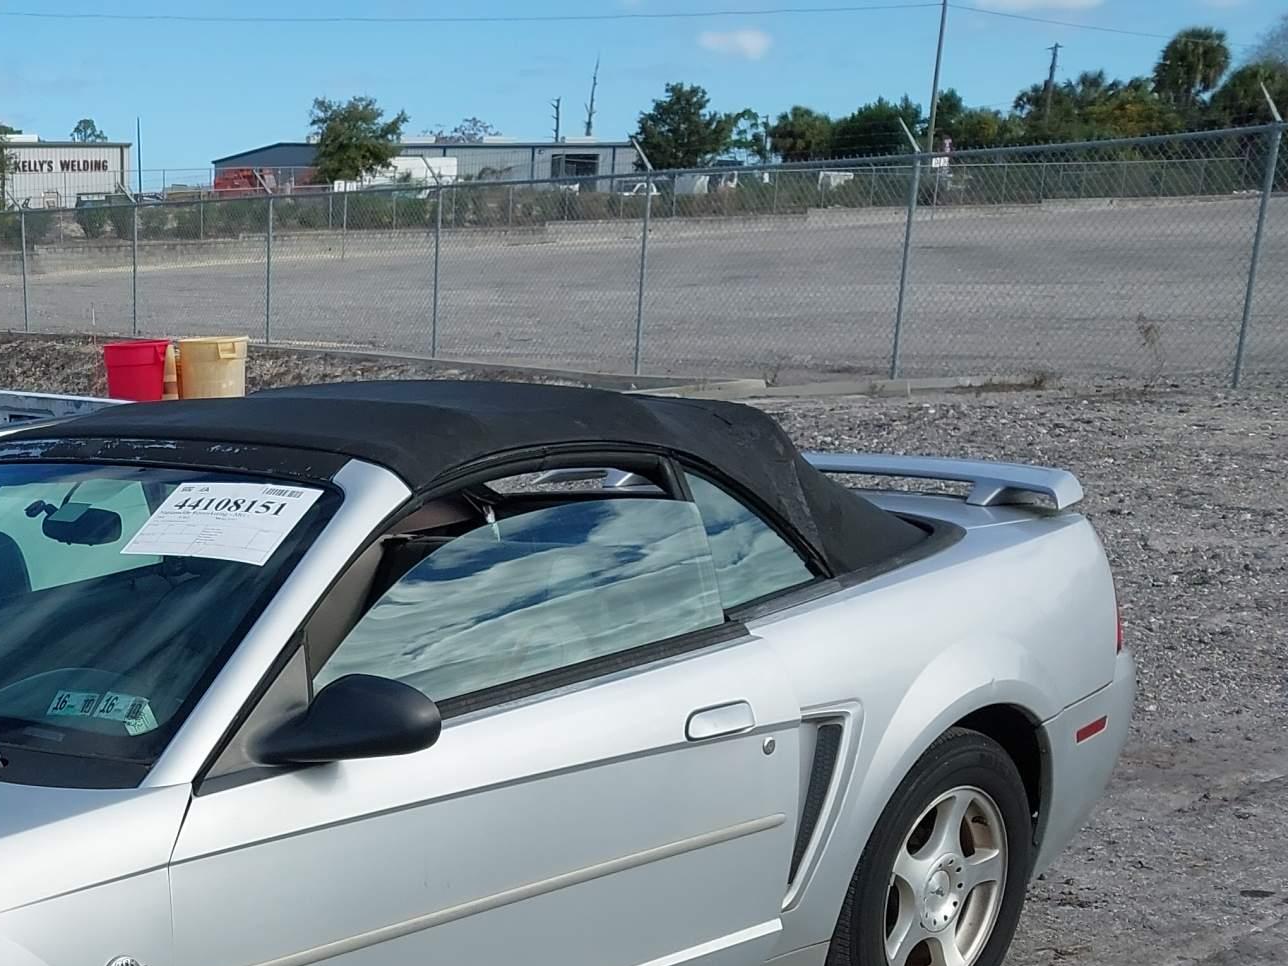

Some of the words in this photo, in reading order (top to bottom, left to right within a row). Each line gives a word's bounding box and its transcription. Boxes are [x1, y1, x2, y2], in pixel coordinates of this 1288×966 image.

[14, 160, 54, 172] KELLY'S
[59, 160, 108, 172] WELDING
[174, 497, 288, 516] 44108151
[53, 694, 70, 711] 16
[100, 696, 118, 714] 16
